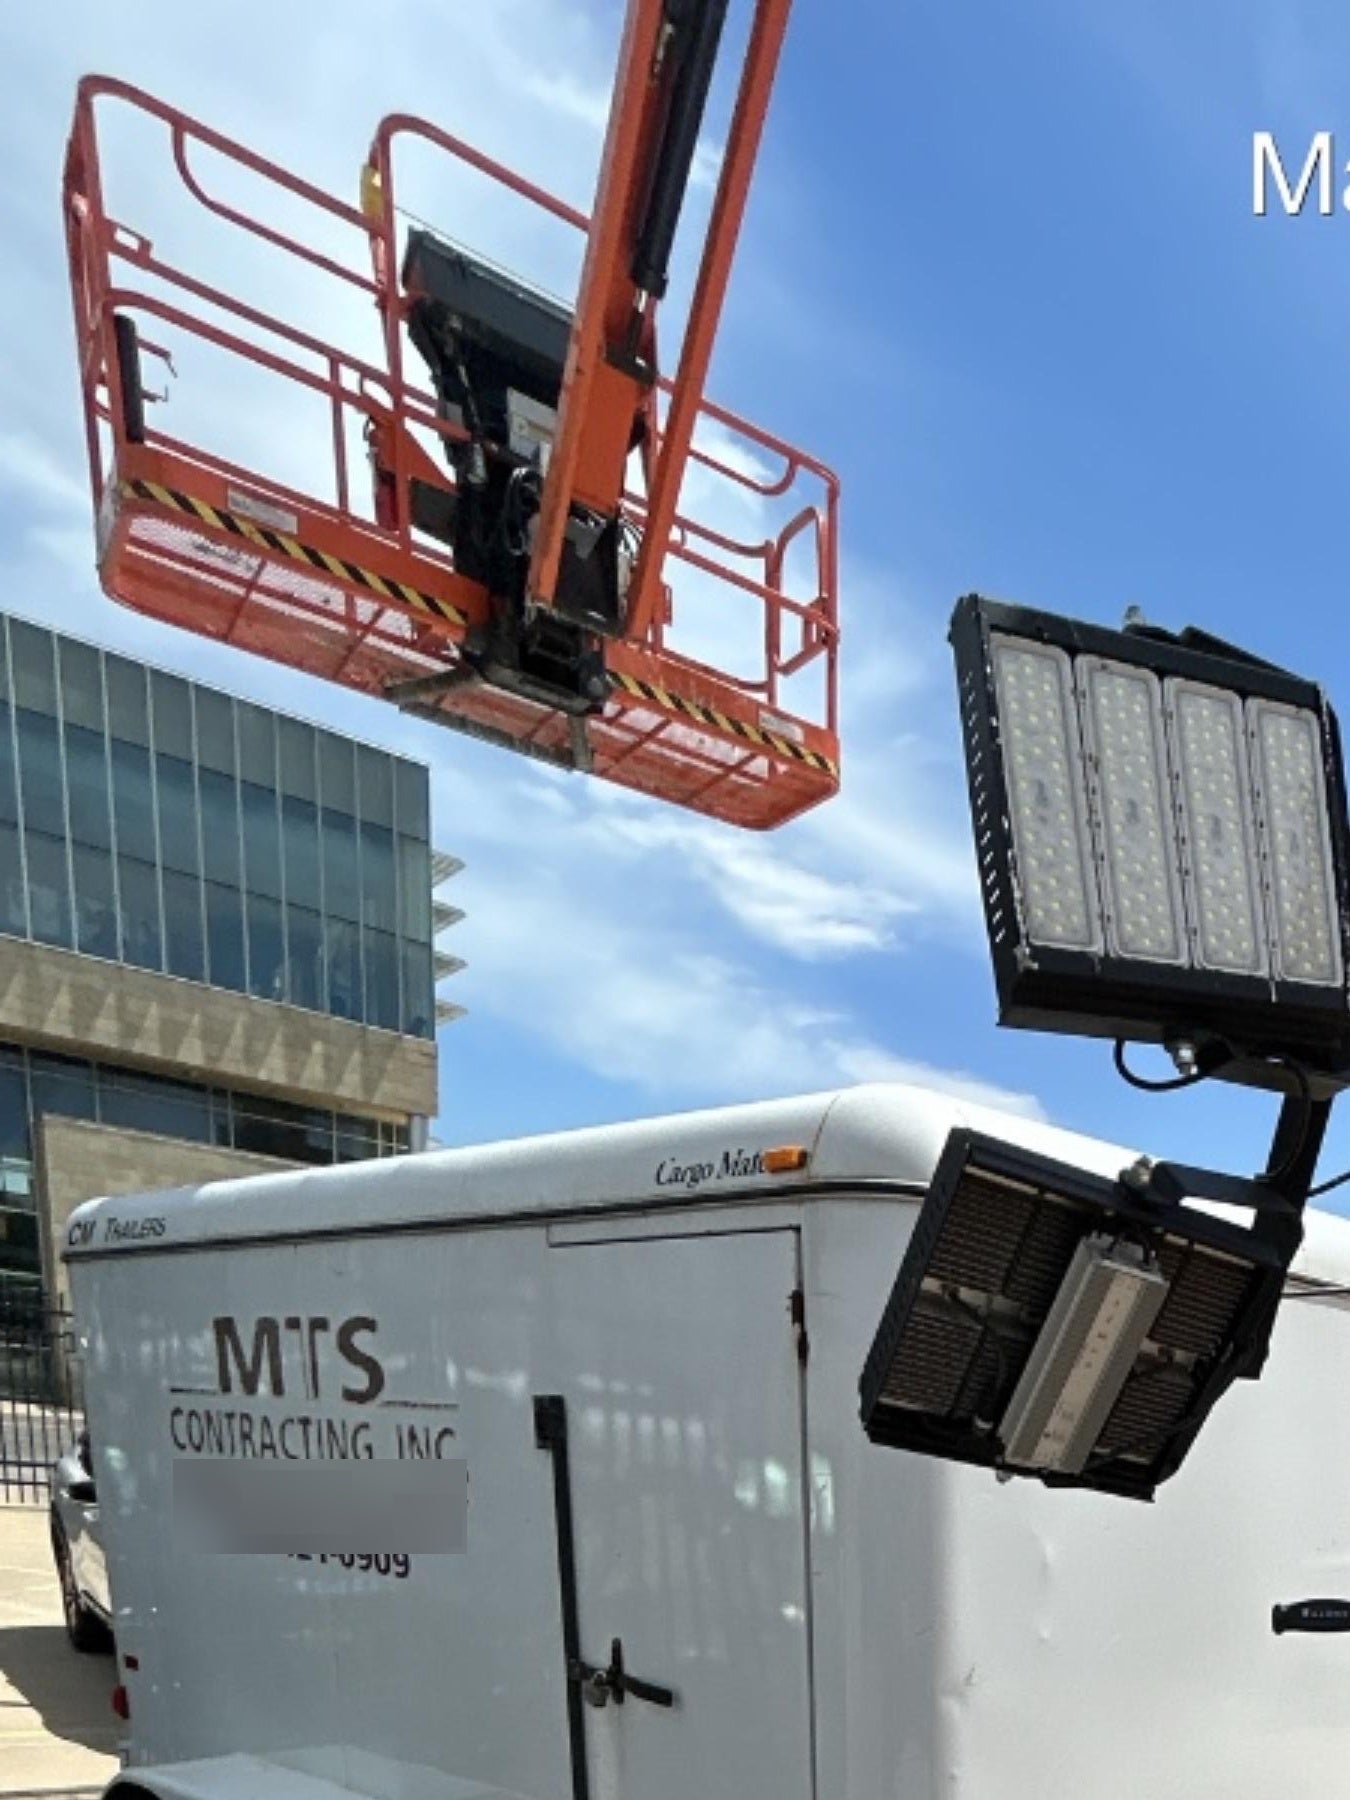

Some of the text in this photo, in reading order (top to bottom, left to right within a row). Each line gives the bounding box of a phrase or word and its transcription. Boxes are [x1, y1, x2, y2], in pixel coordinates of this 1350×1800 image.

[656, 1158, 715, 1188] Cargo
[212, 1316, 386, 1405] MTS
[170, 1406, 375, 1461] CONTRACTING
